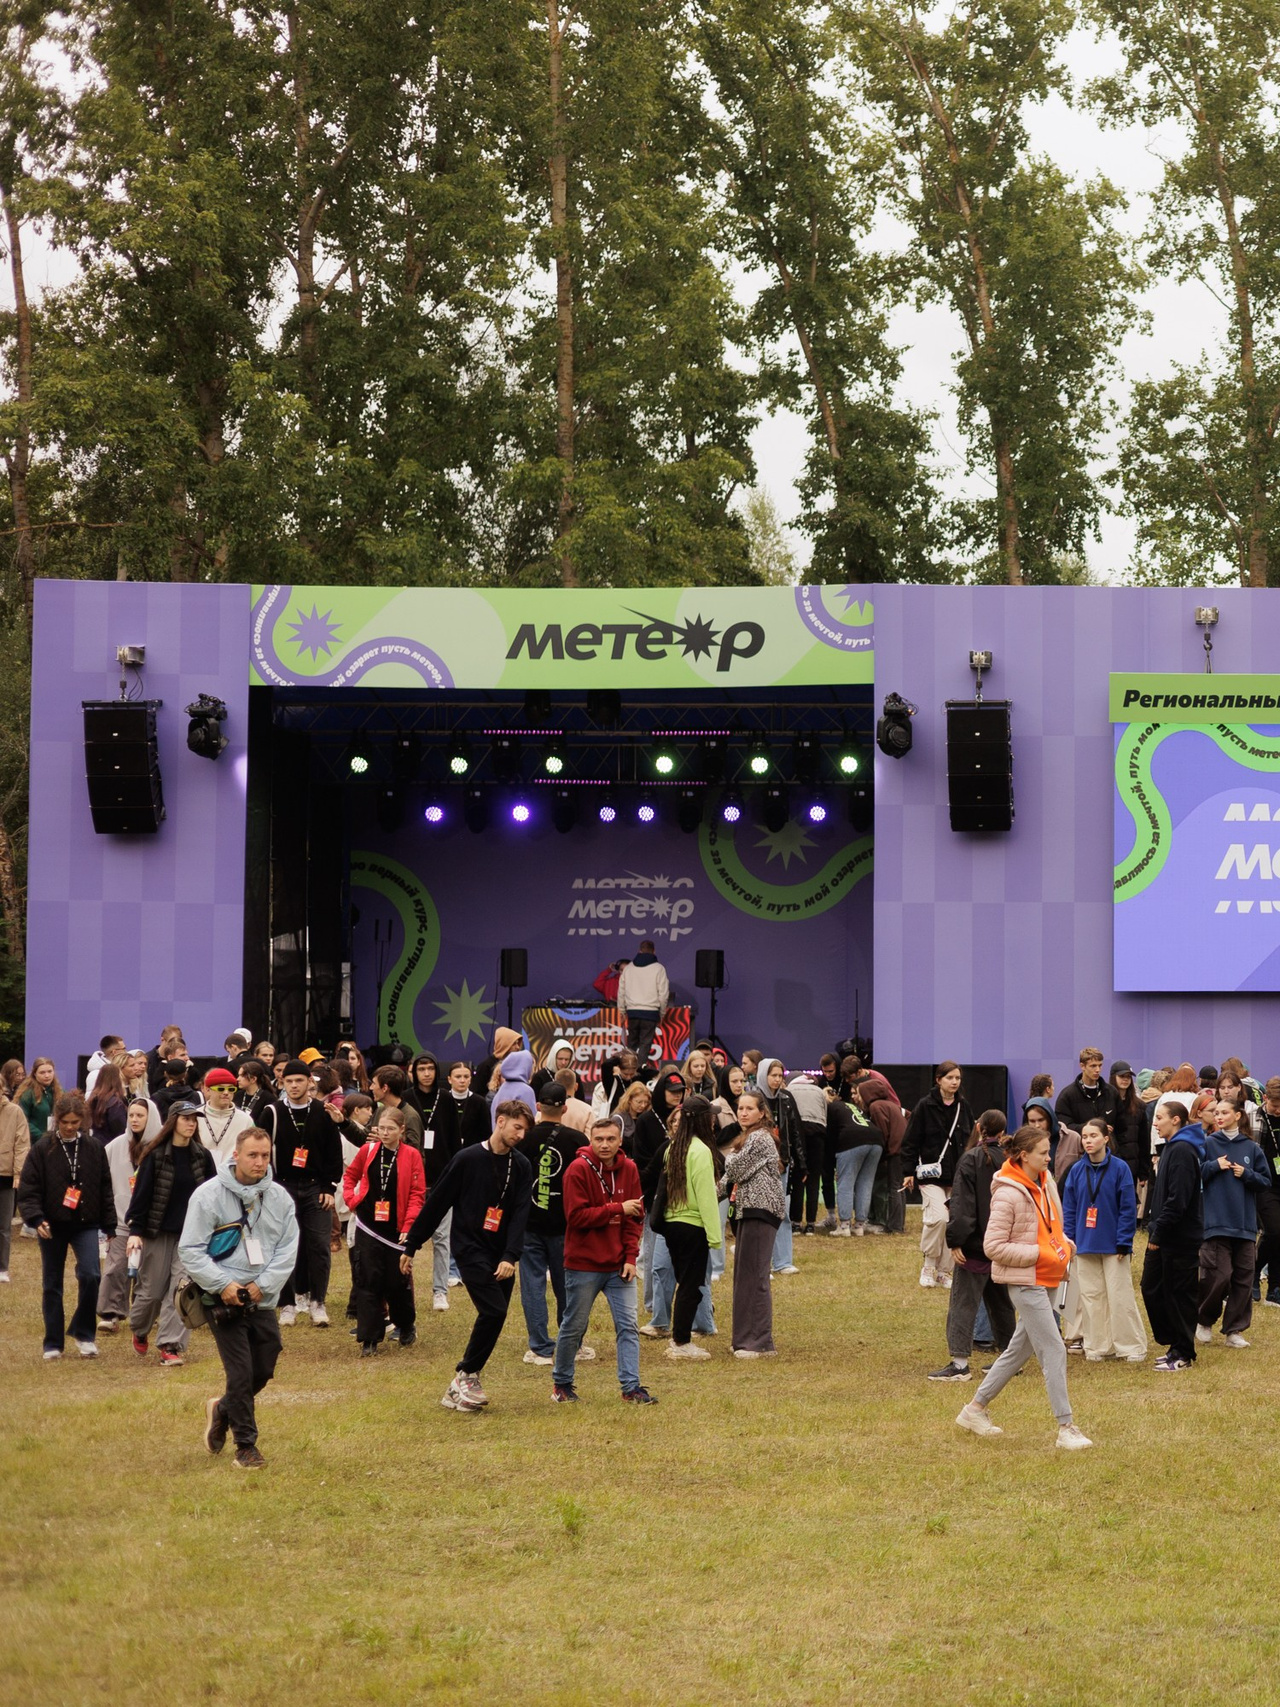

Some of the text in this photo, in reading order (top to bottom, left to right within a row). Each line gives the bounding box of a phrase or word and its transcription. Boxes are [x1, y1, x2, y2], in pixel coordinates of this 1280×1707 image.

[803, 600, 812, 612] за
[808, 613, 843, 644] мечтой,
[845, 638, 871, 648] путь
[255, 647, 264, 659] за
[345, 647, 379, 677] озаряет
[381, 645, 411, 659] пусть
[1216, 723, 1249, 750] пусть
[1129, 747, 1141, 779] путь
[1130, 781, 1160, 830] мечтой,
[1152, 832, 1160, 846] за
[368, 863, 421, 898] верный
[710, 849, 722, 865] за
[717, 867, 763, 909] мечтой,
[766, 902, 800, 915] путь
[804, 883, 830, 908] мой
[388, 938, 426, 1028] отправляюсь
